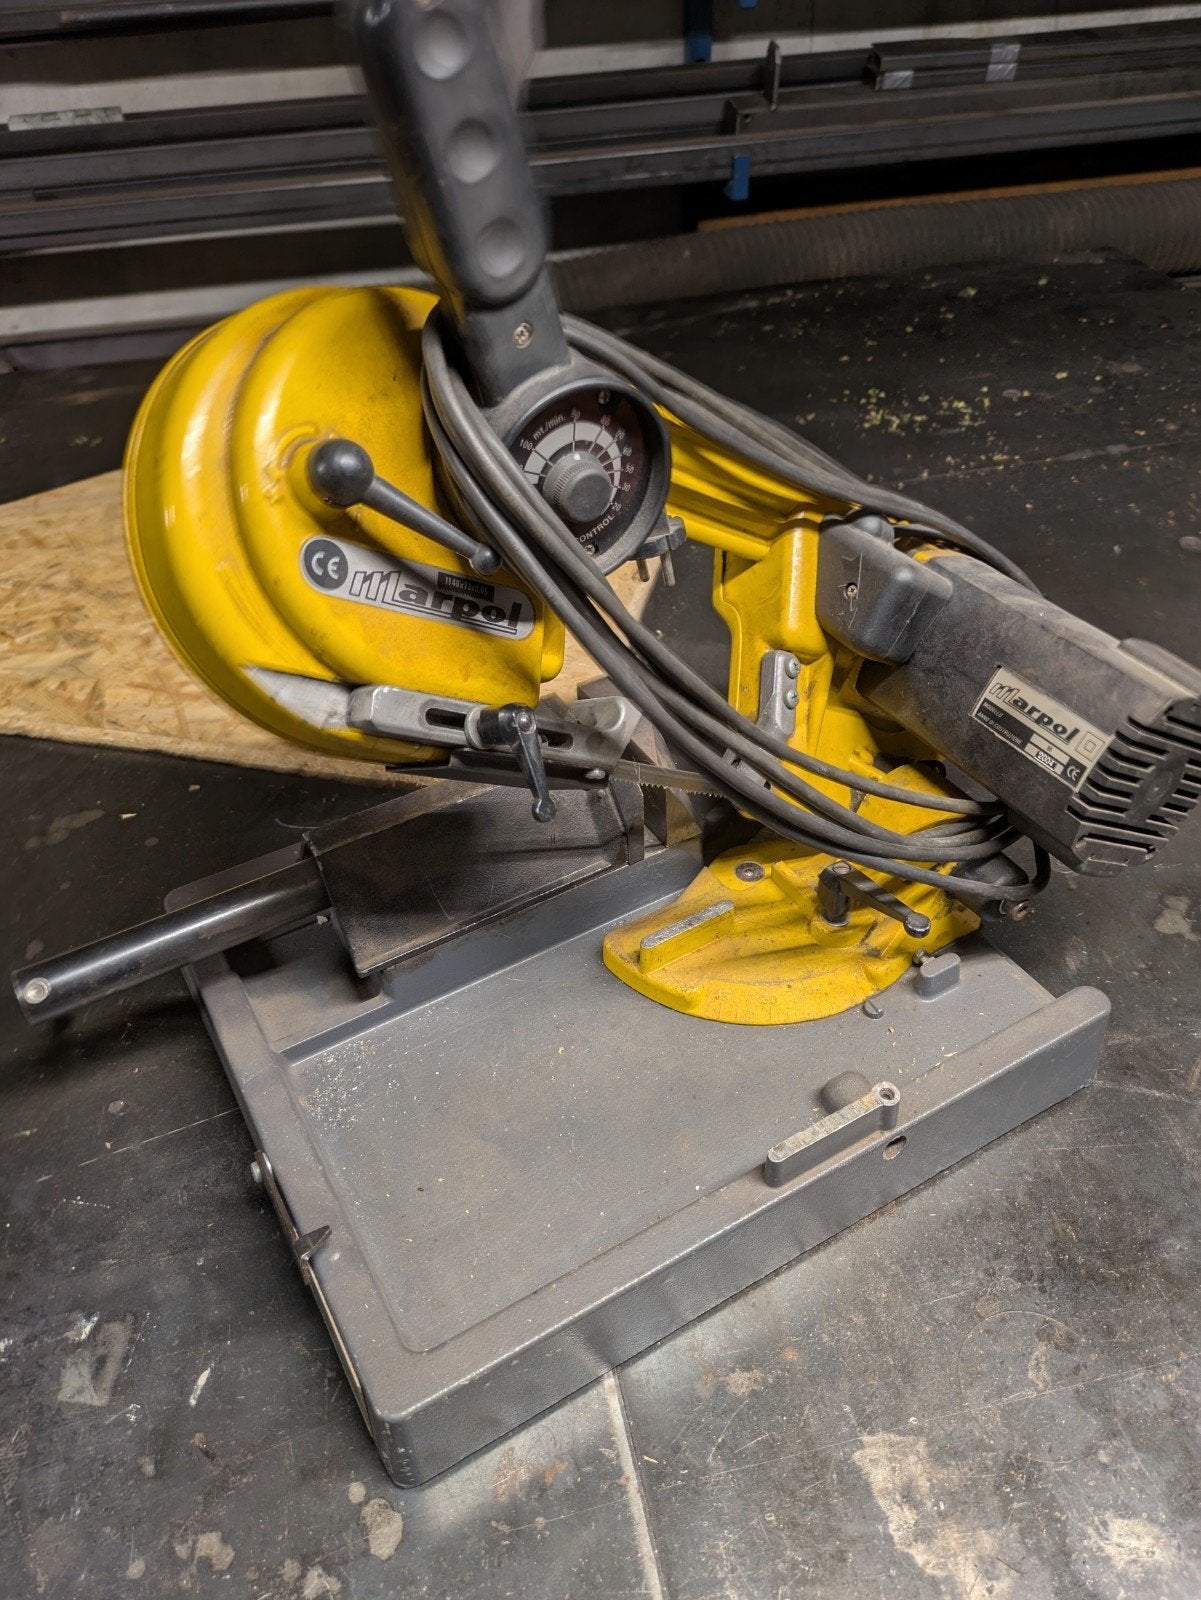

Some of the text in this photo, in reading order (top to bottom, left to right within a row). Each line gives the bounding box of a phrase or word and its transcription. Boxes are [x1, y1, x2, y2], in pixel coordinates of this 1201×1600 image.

[519, 438, 534, 451] 100
[311, 550, 341, 580] CE
[349, 571, 523, 634] Marpol
[988, 682, 1081, 745] Marpol
[1066, 765, 1081, 781] CE
